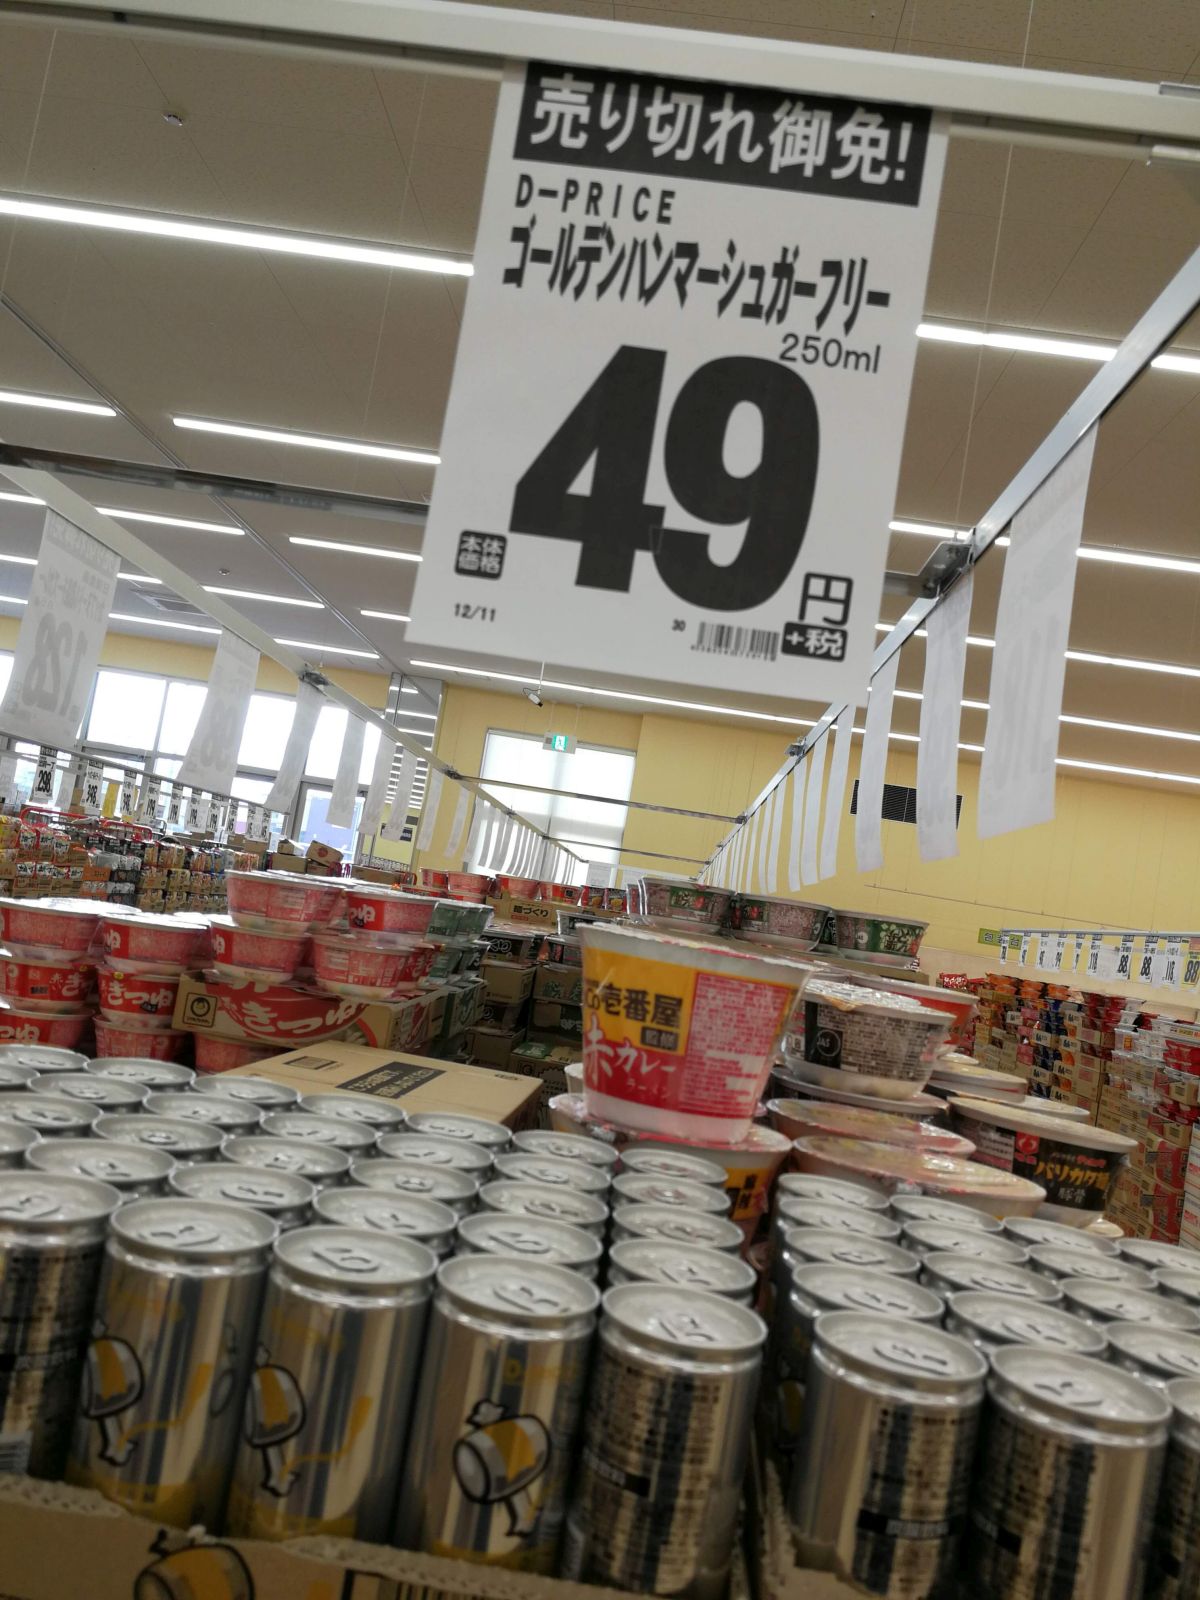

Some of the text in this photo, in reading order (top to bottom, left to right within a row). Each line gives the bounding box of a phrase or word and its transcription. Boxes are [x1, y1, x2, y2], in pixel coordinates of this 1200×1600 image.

[529, 72, 914, 185] 売り切れ御免!
[779, 333, 881, 373] 250ml
[509, 344, 820, 613] 49
[454, 602, 496, 622] 12/11
[798, 572, 853, 626] 円
